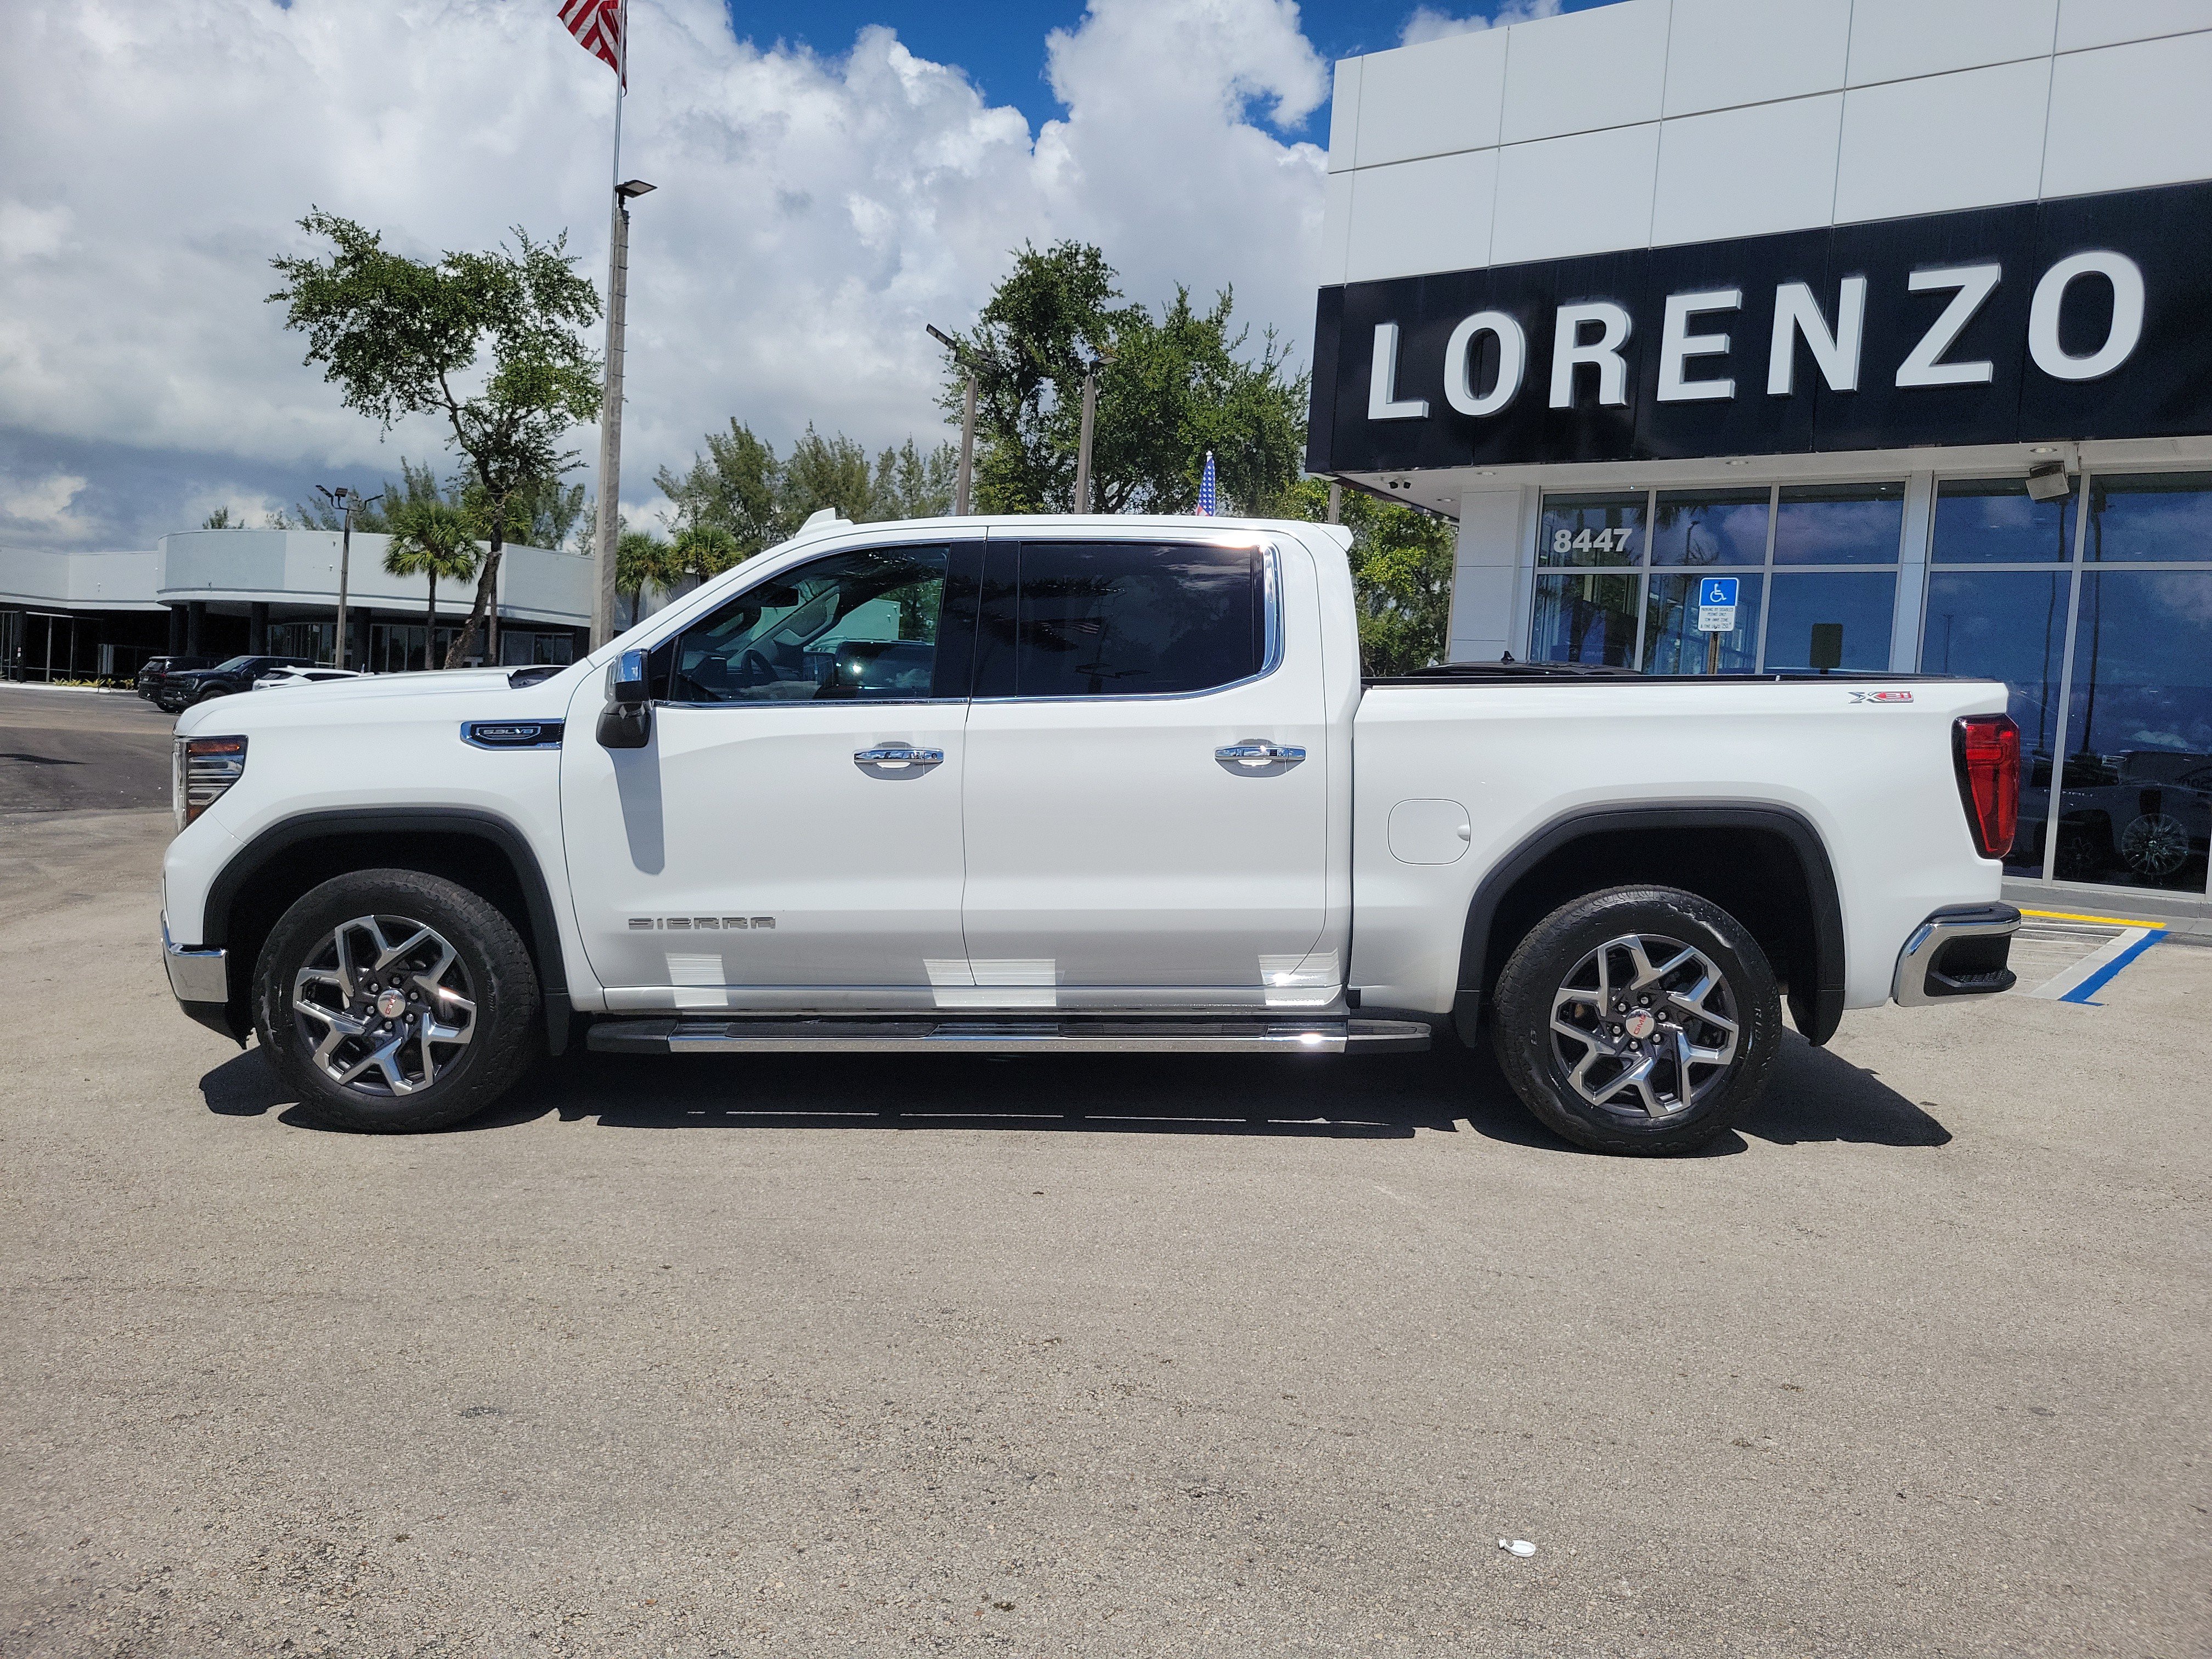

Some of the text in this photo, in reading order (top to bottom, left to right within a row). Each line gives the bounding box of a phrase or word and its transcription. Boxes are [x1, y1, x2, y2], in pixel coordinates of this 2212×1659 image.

[1368, 249, 2147, 420] LORENZO
[1554, 528, 1632, 553] 8447
[628, 917, 776, 930] SIERRA
[1633, 1014, 1647, 1035] GMC
